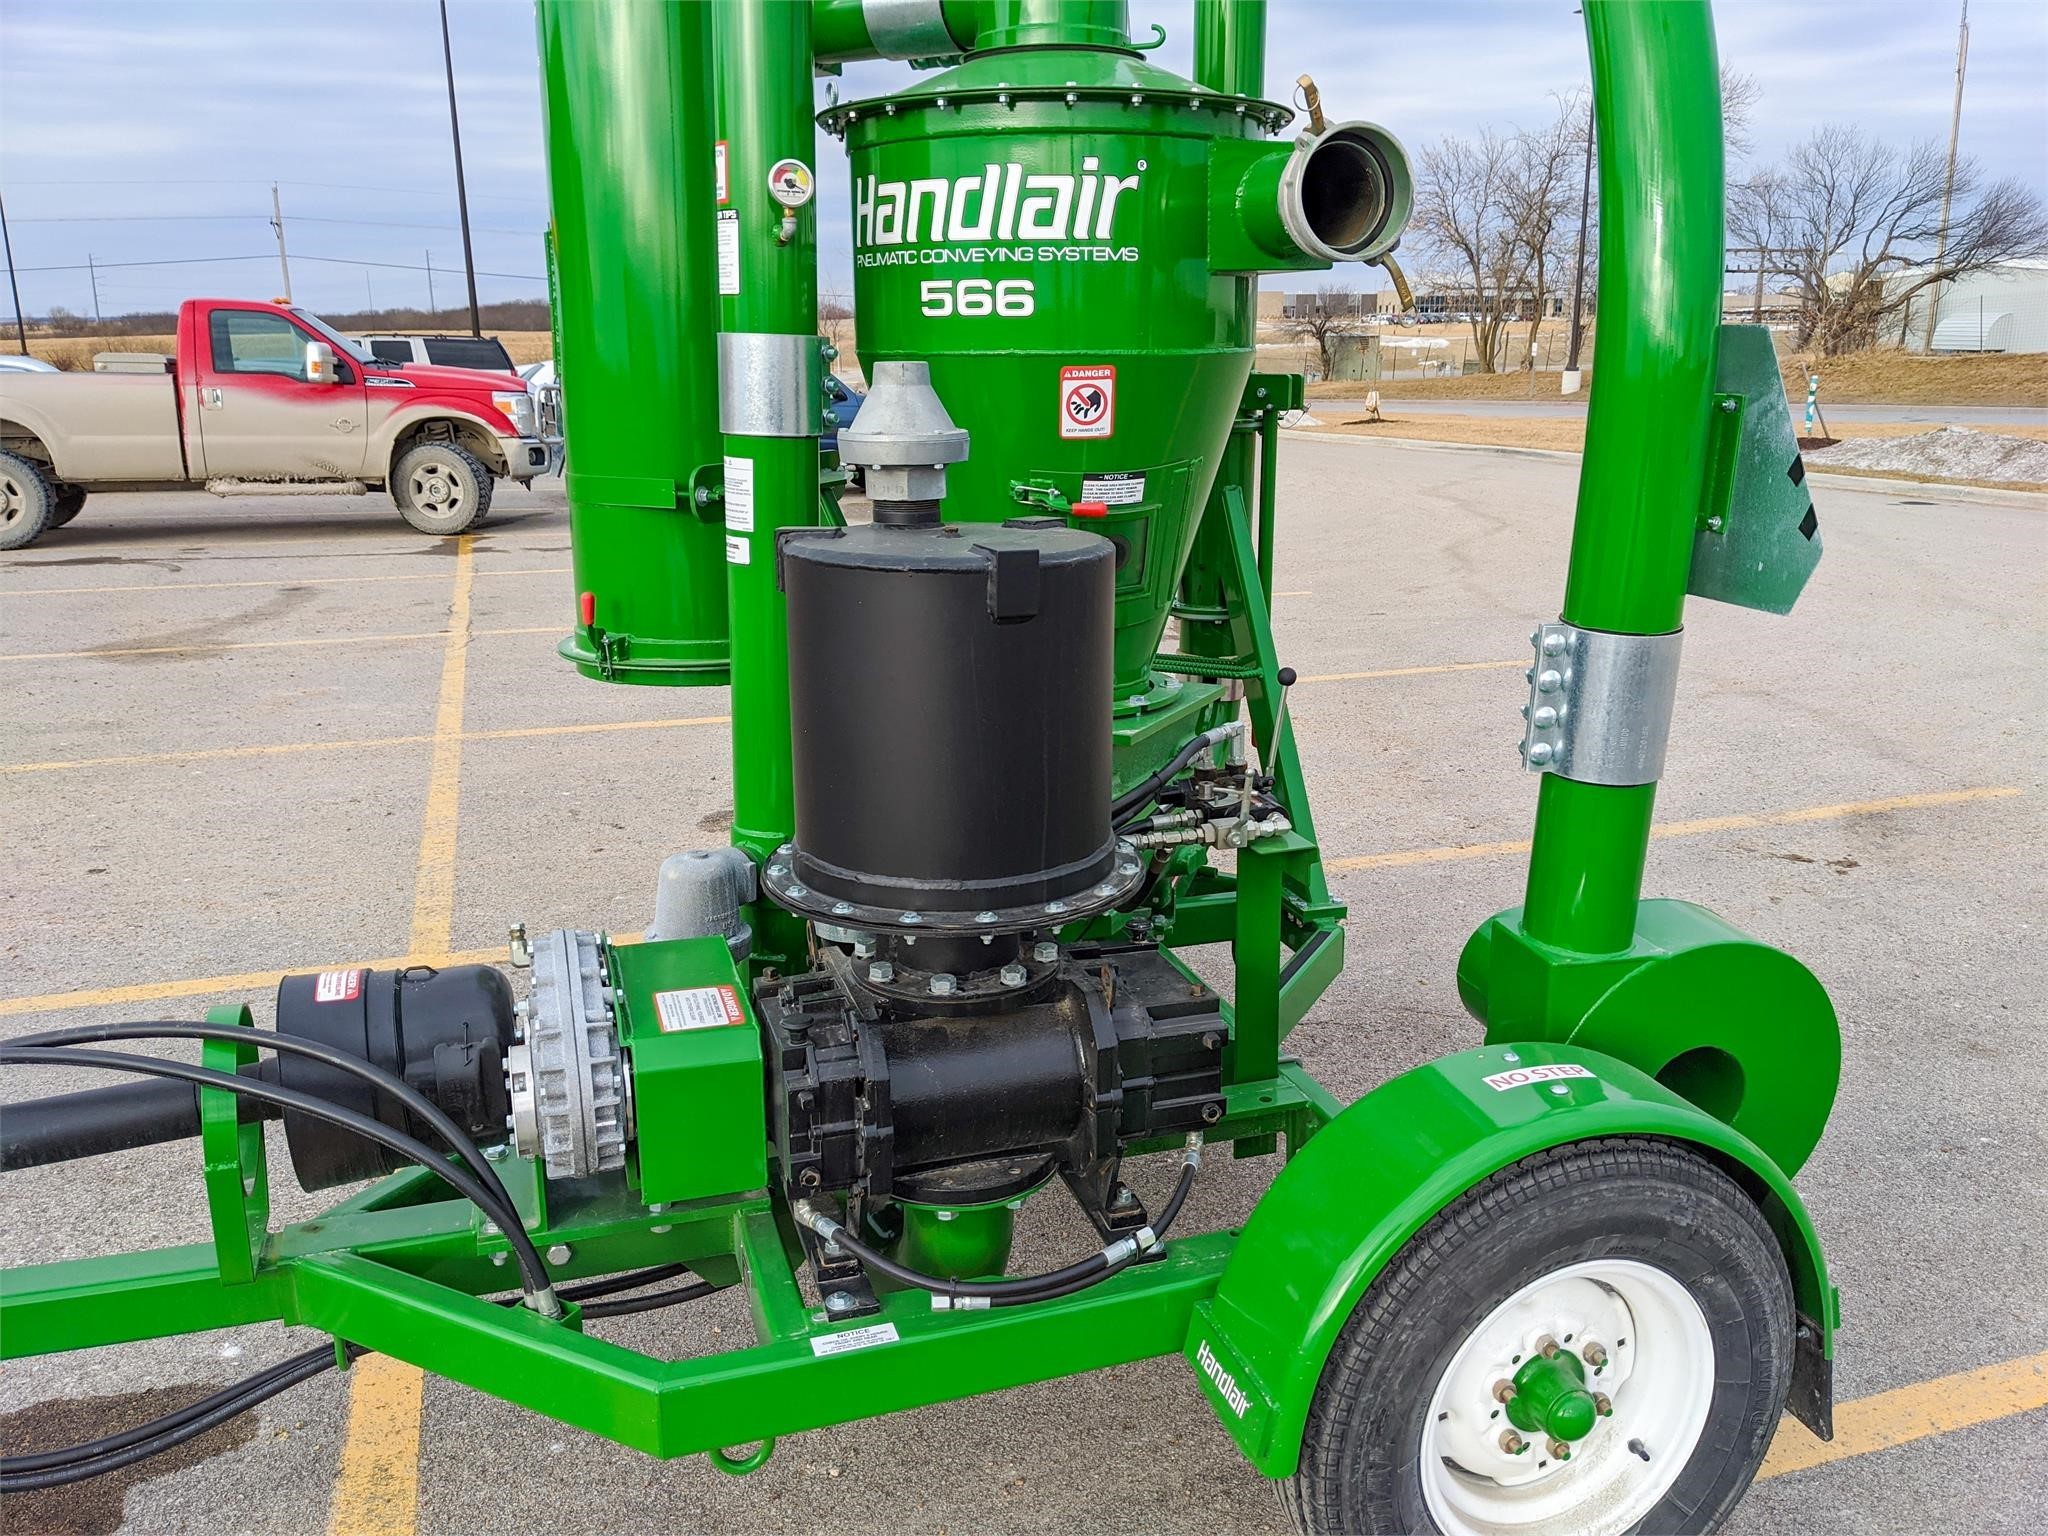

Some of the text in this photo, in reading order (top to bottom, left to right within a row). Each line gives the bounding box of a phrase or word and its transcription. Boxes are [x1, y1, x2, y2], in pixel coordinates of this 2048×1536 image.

[857, 156, 1140, 248] Handlair
[857, 246, 1139, 268] PNEUMATIC CONVEYING SYSTEMS
[920, 279, 1035, 317] 566
[1072, 369, 1111, 378] DANGER
[721, 990, 740, 1018] DANGER
[1488, 1066, 1585, 1089] NO STEP
[836, 1328, 870, 1338] NOTICE
[1196, 1339, 1251, 1420] Handlair
